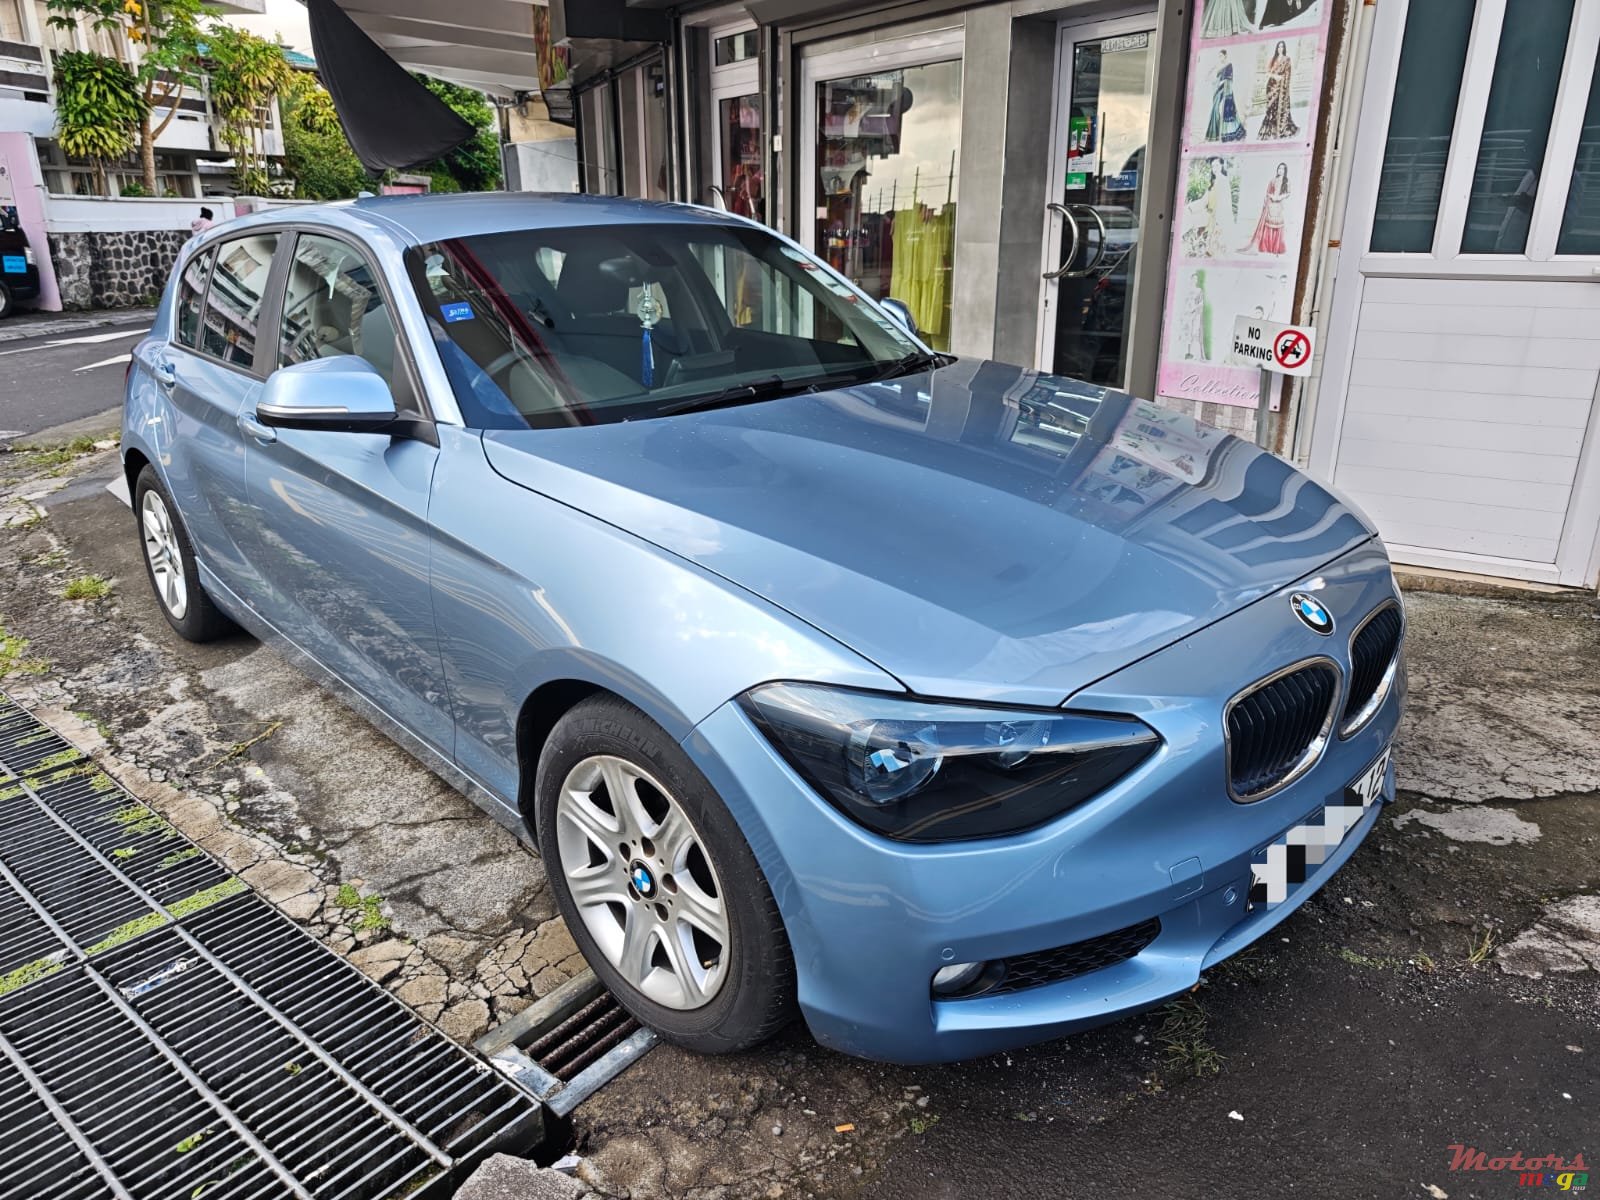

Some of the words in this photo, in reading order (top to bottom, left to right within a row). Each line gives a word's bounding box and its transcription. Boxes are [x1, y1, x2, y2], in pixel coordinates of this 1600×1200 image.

[1248, 326, 1261, 341] NO
[1234, 341, 1273, 362] PARKING
[1180, 374, 1260, 400] Collection
[577, 717, 659, 759] MICHELIN
